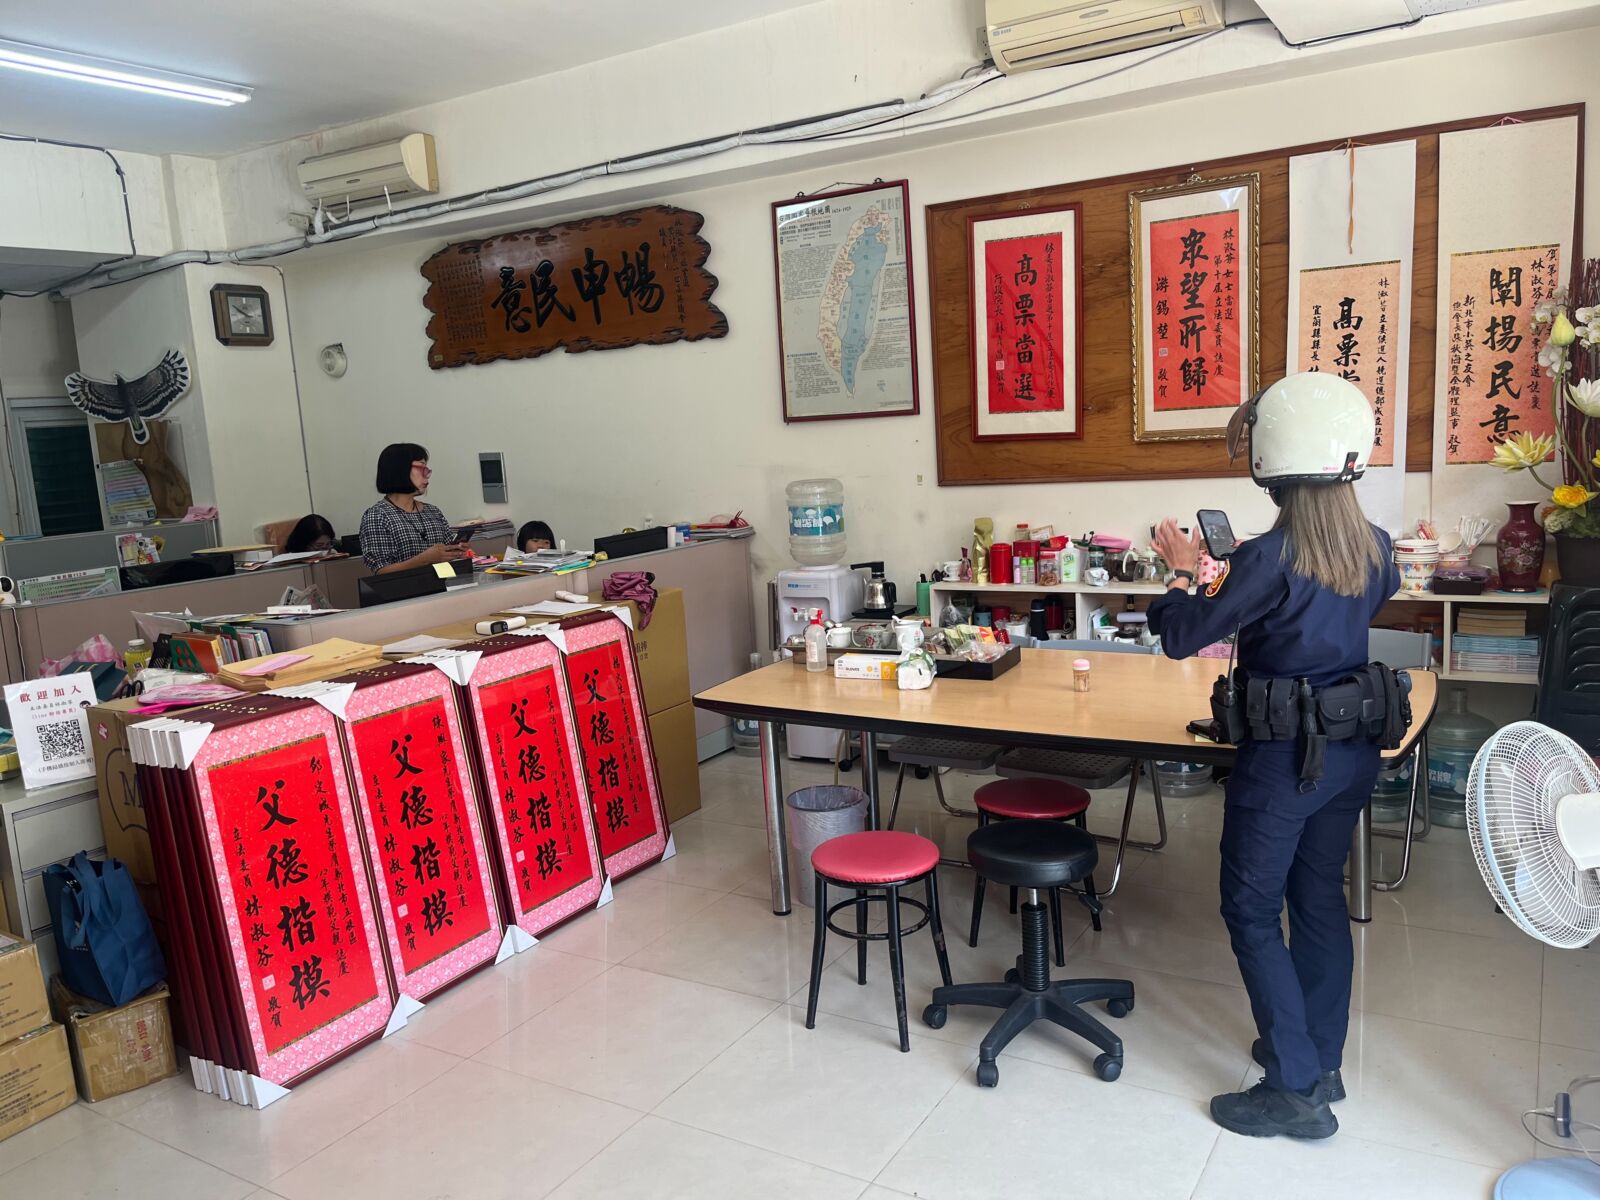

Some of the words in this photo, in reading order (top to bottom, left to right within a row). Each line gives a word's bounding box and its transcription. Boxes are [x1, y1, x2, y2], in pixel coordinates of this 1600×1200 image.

[1014, 254, 1038, 401] 高票當選
[1179, 228, 1210, 397] 眾望所歸
[1223, 226, 1236, 320] 林淑芬女士當選
[1463, 294, 1476, 388] 新北市小英之友會
[20, 685, 82, 703] 歡迎加入
[582, 668, 630, 834] 父德楷模
[388, 733, 454, 937] 父德楷模
[510, 698, 563, 881] 父德楷模
[244, 893, 274, 969] 林淑芬
[255, 779, 331, 1010] 父德楷模
[383, 832, 409, 897] 林淑芬
